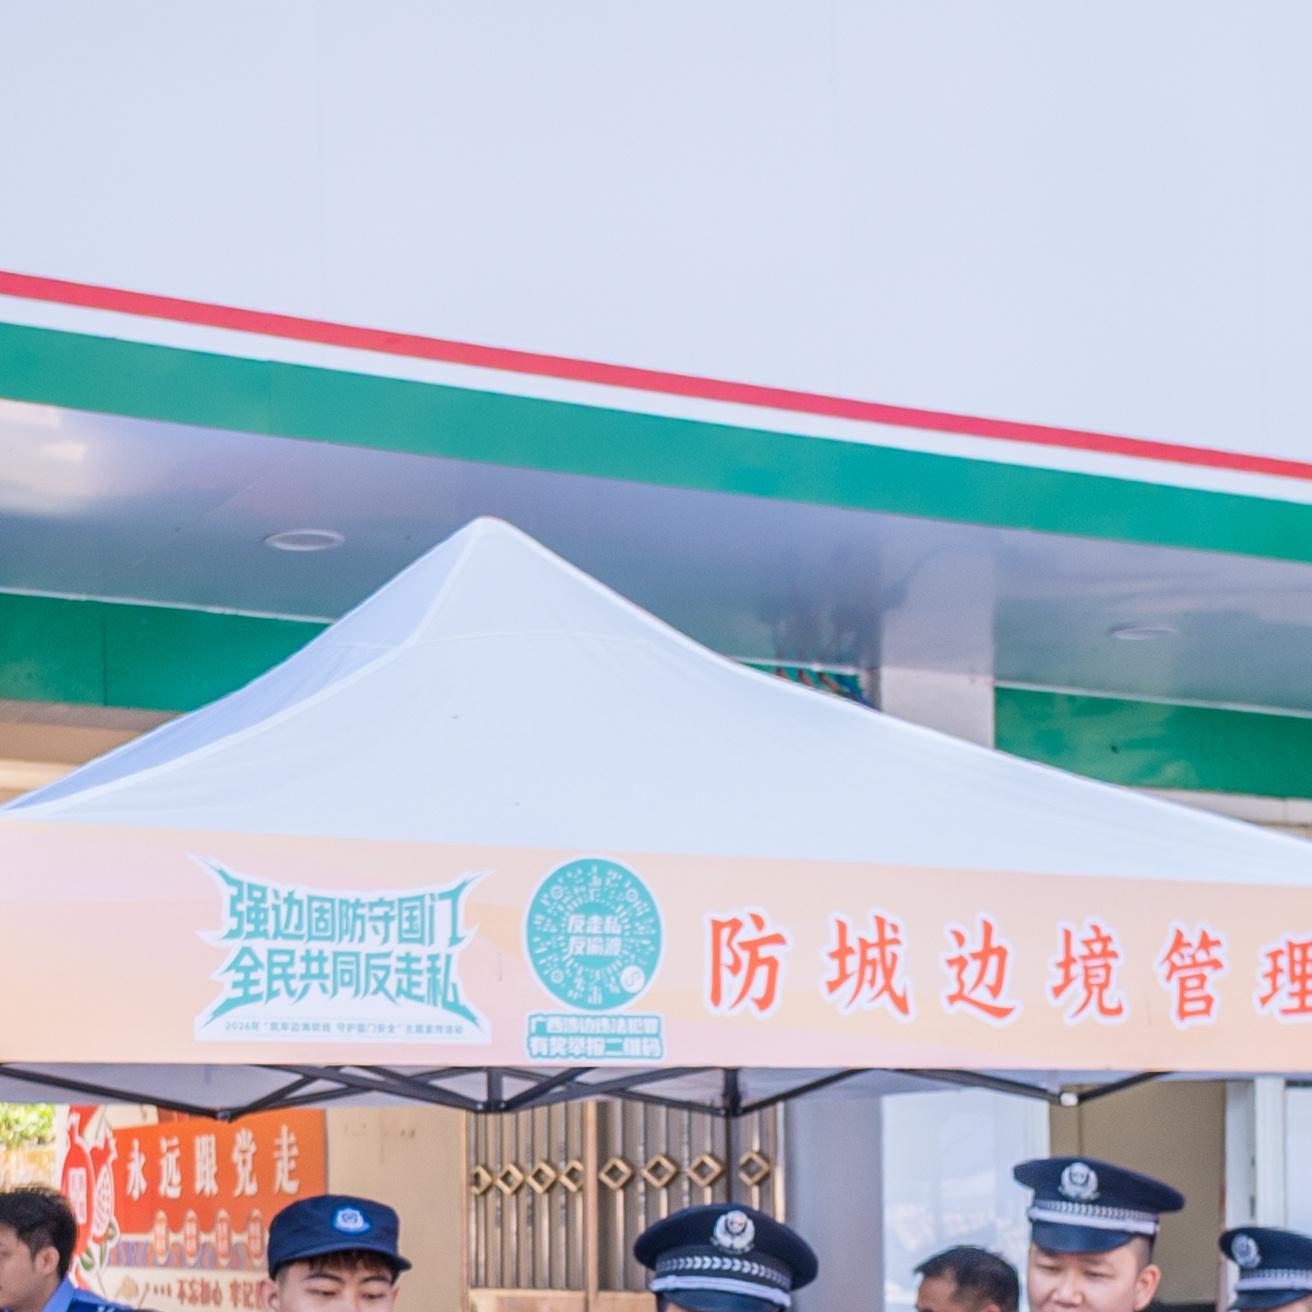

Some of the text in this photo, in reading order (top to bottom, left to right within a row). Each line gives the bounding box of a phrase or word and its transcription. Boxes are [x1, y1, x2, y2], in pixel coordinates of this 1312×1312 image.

[213, 872, 478, 948] 强边固防守国门
[216, 945, 472, 1018] 全民共同反走私
